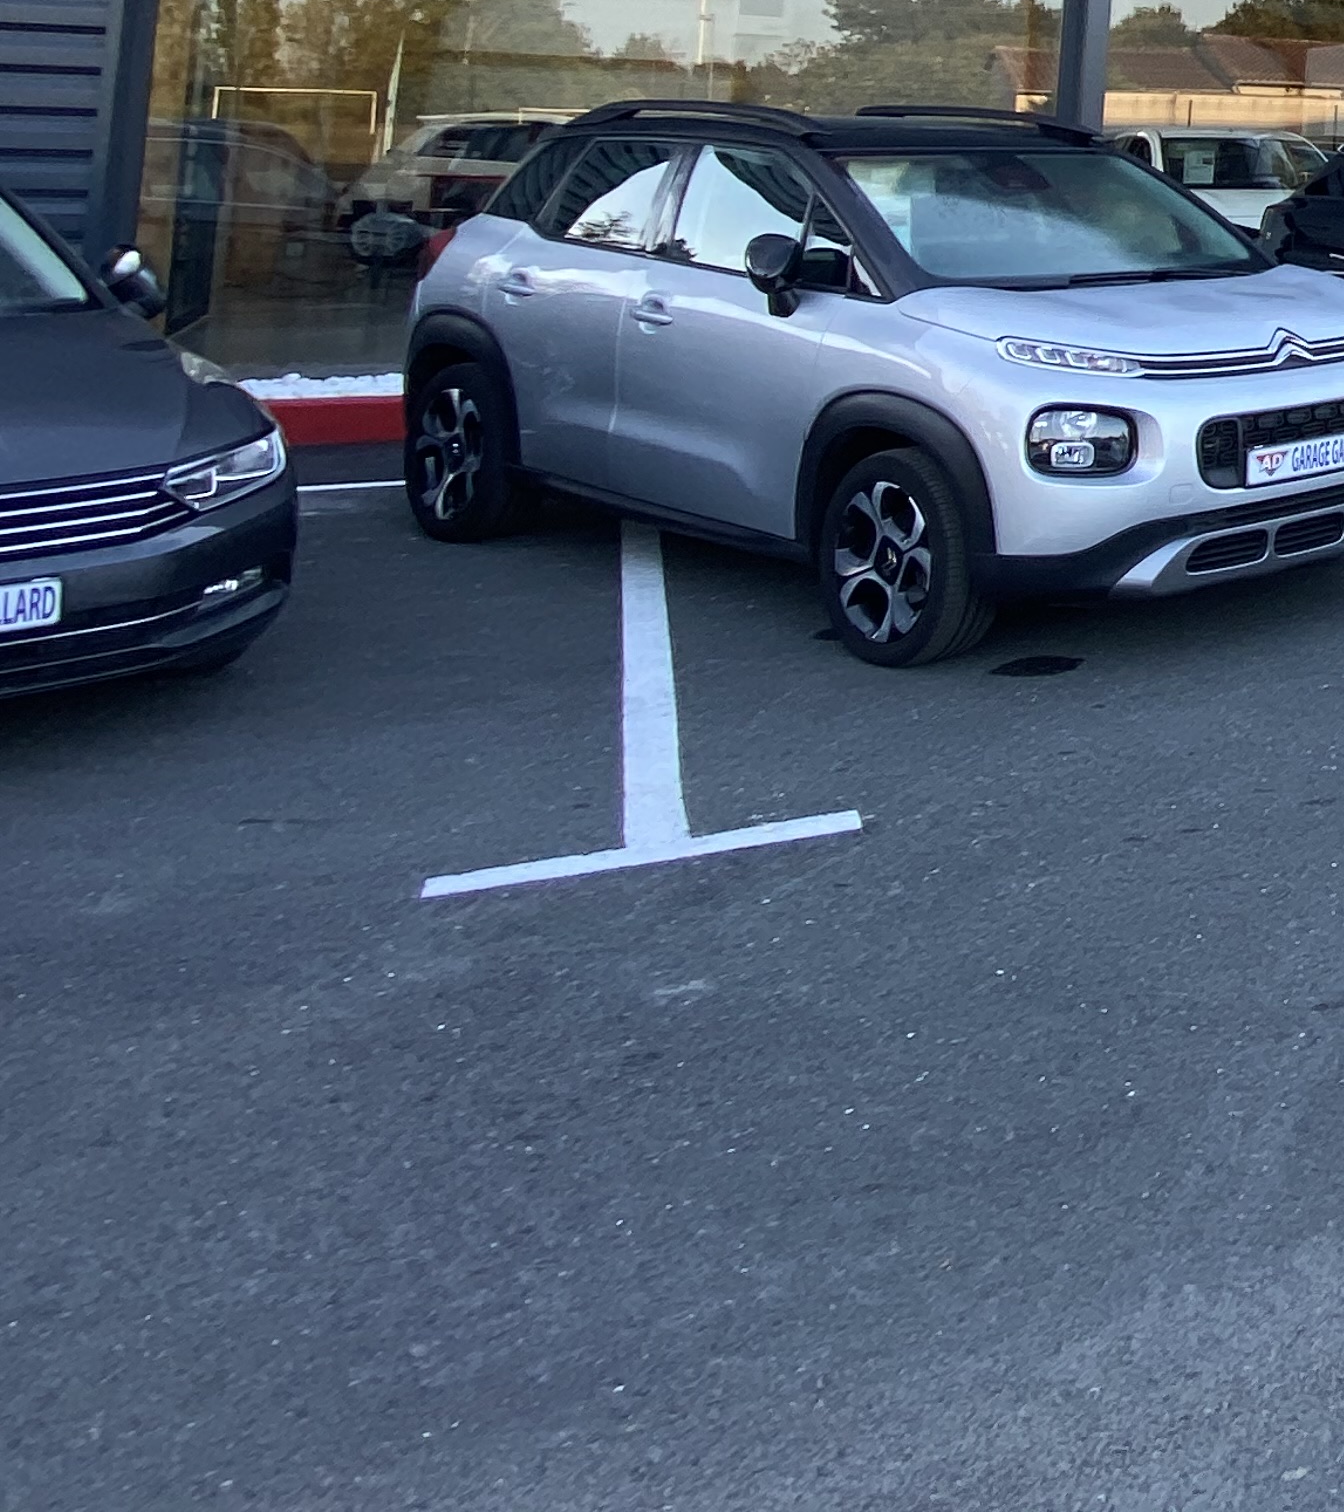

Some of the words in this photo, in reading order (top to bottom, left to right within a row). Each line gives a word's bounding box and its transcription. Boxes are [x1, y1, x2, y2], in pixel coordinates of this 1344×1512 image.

[1260, 452, 1285, 472] AD
[1292, 441, 1330, 471] GARAGE
[0, 586, 56, 625] LARD
